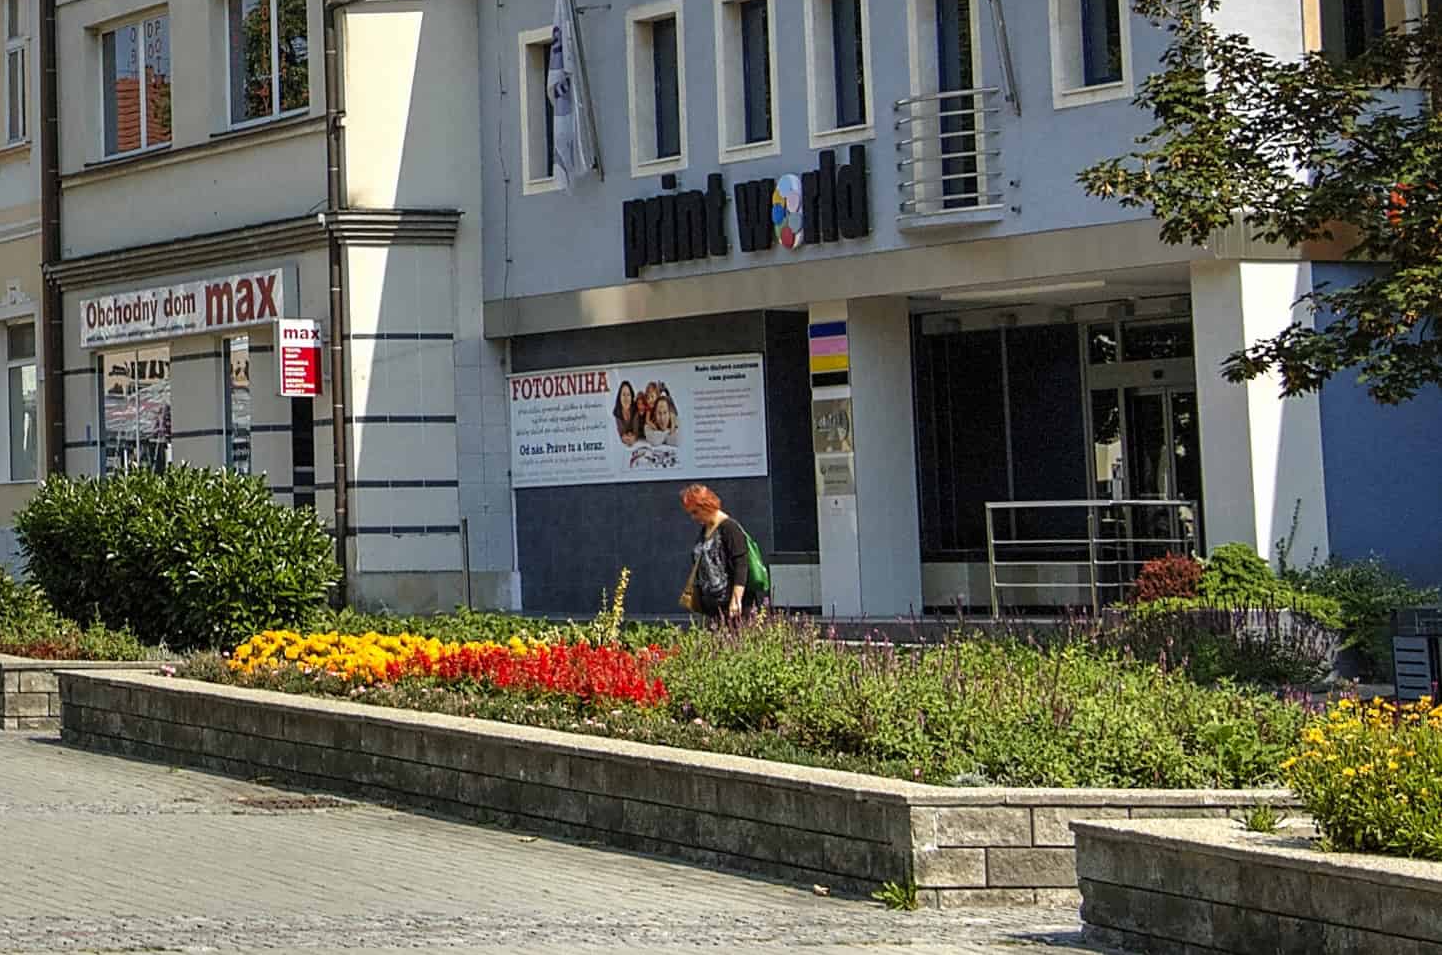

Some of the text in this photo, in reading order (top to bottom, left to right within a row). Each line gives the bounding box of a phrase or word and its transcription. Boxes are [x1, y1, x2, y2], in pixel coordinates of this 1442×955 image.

[86, 275, 278, 329] Obchodný dom max
[283, 328, 320, 341] max
[511, 372, 610, 401] FOTOKNIHA
